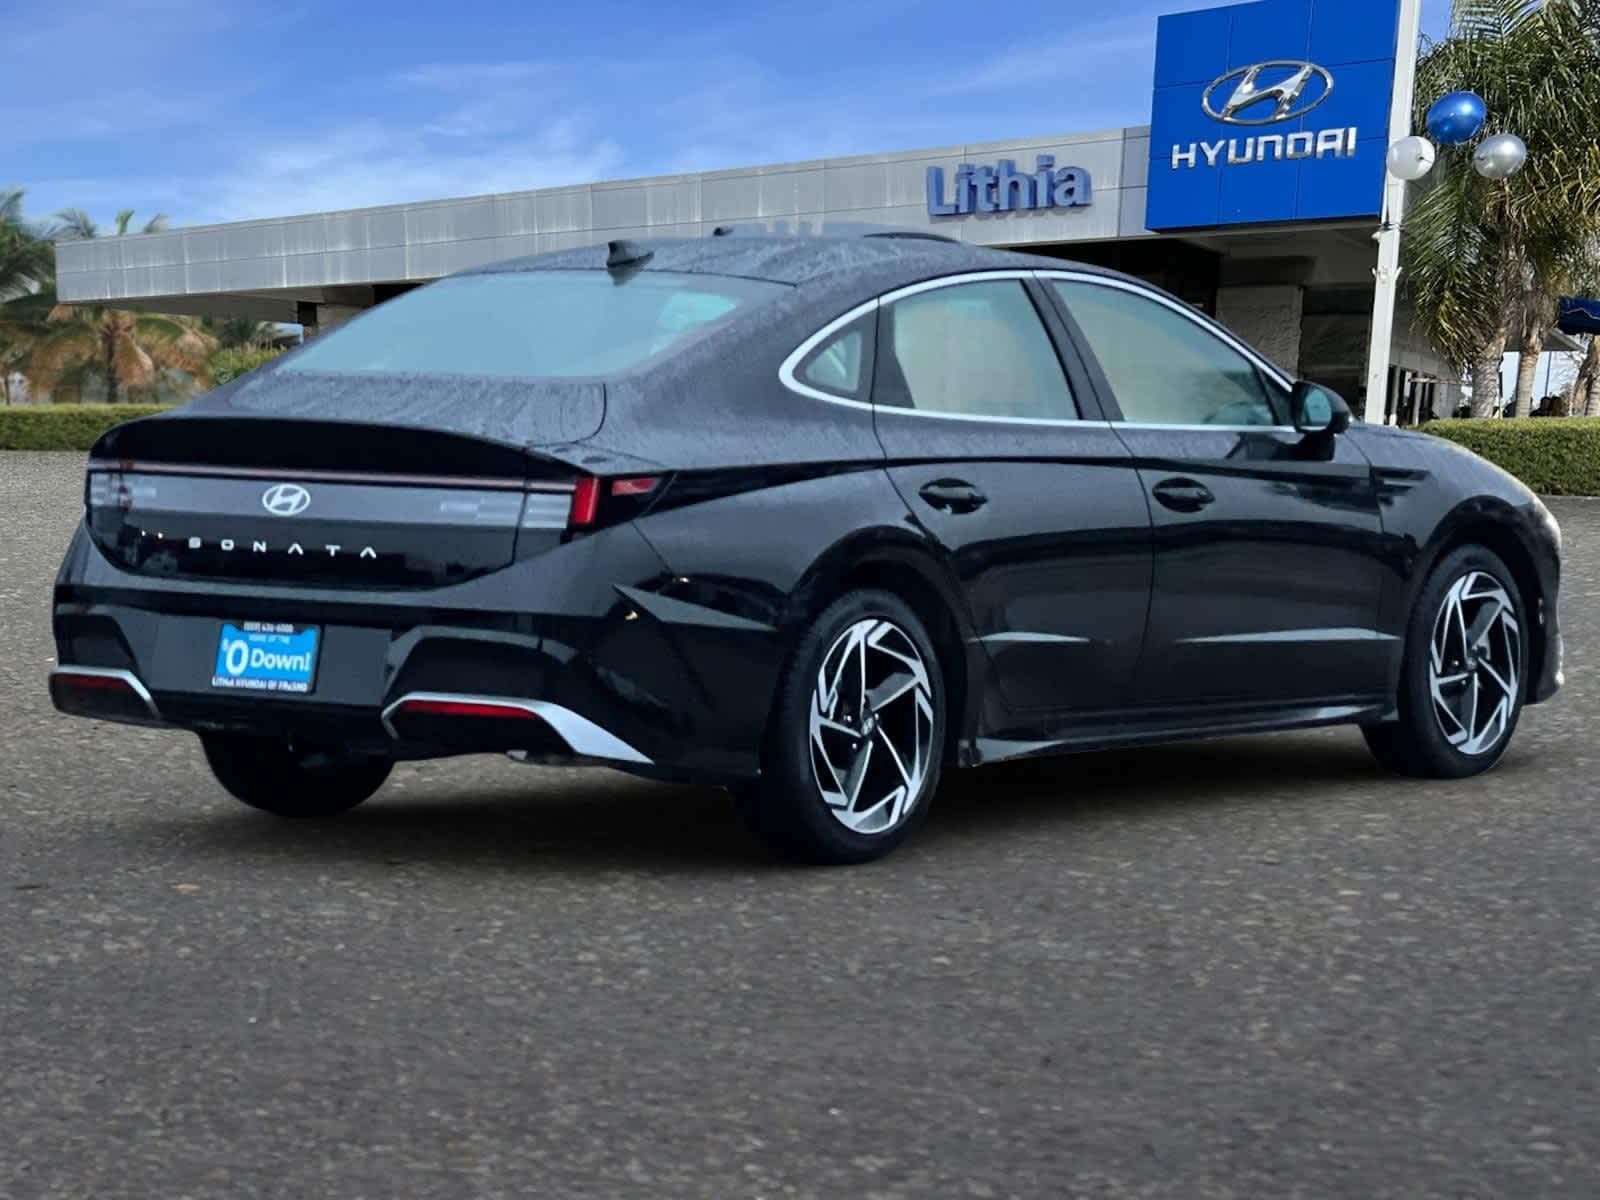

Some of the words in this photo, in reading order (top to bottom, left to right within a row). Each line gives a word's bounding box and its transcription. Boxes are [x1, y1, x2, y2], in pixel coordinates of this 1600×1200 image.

[1171, 127, 1357, 169] HYUNDAI
[926, 155, 1092, 216] Lithia
[188, 536, 377, 559] SONATA
[251, 648, 311, 672] Down!
